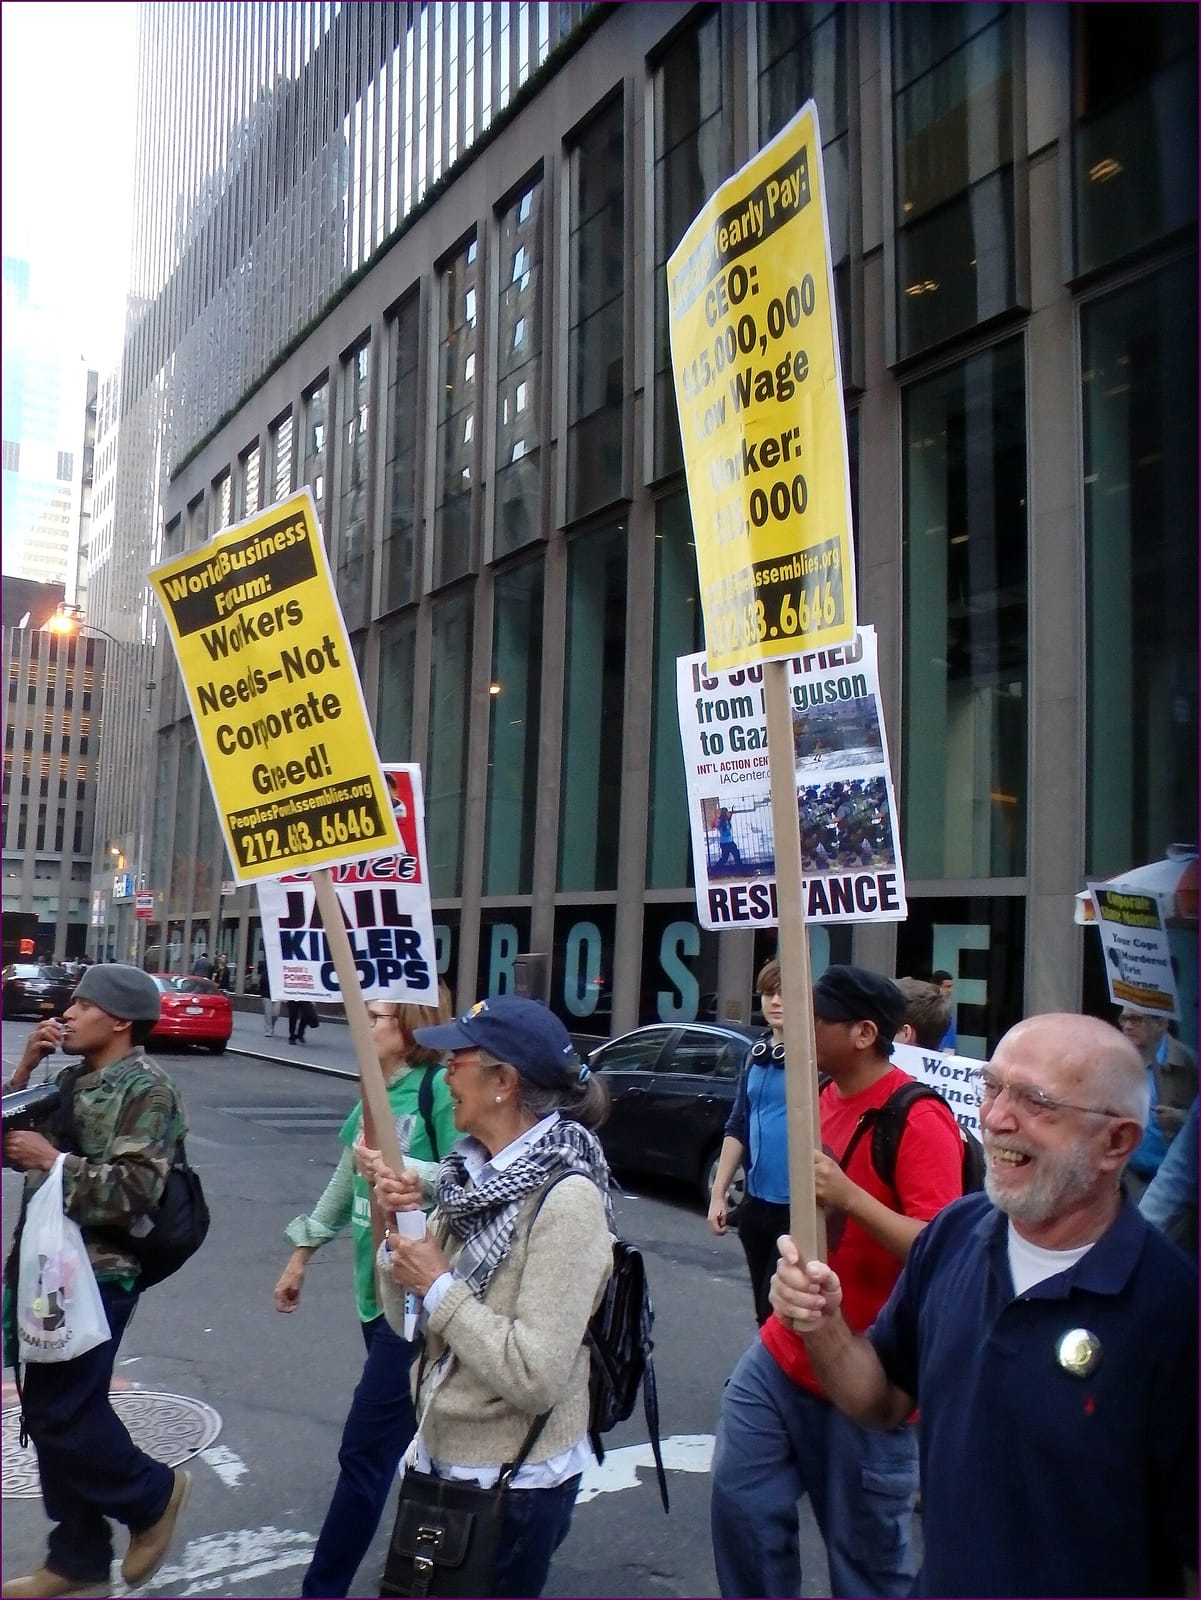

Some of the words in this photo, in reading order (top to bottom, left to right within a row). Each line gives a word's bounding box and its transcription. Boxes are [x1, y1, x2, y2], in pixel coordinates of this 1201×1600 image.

[766, 165, 807, 219] Pay:
[705, 264, 760, 328] CEO:
[729, 350, 809, 414] Wage
[710, 427, 802, 492] Worker:
[219, 522, 307, 576] Business
[200, 599, 303, 661] Workers
[728, 634, 864, 687] JUIFIED
[217, 692, 342, 755] Corporate
[695, 695, 754, 724] from
[760, 673, 868, 715] guson
[697, 763, 718, 775] INT'L
[720, 758, 751, 772] ACTION
[753, 756, 769, 767] CEN
[699, 731, 724, 756] to
[729, 725, 768, 752] Gaz
[252, 743, 333, 795] Greed!
[720, 769, 771, 785] IACenter.
[278, 888, 414, 929] JAIL
[708, 873, 900, 923] RESIANCE
[279, 929, 424, 962] KILLER
[320, 958, 430, 992] COPS
